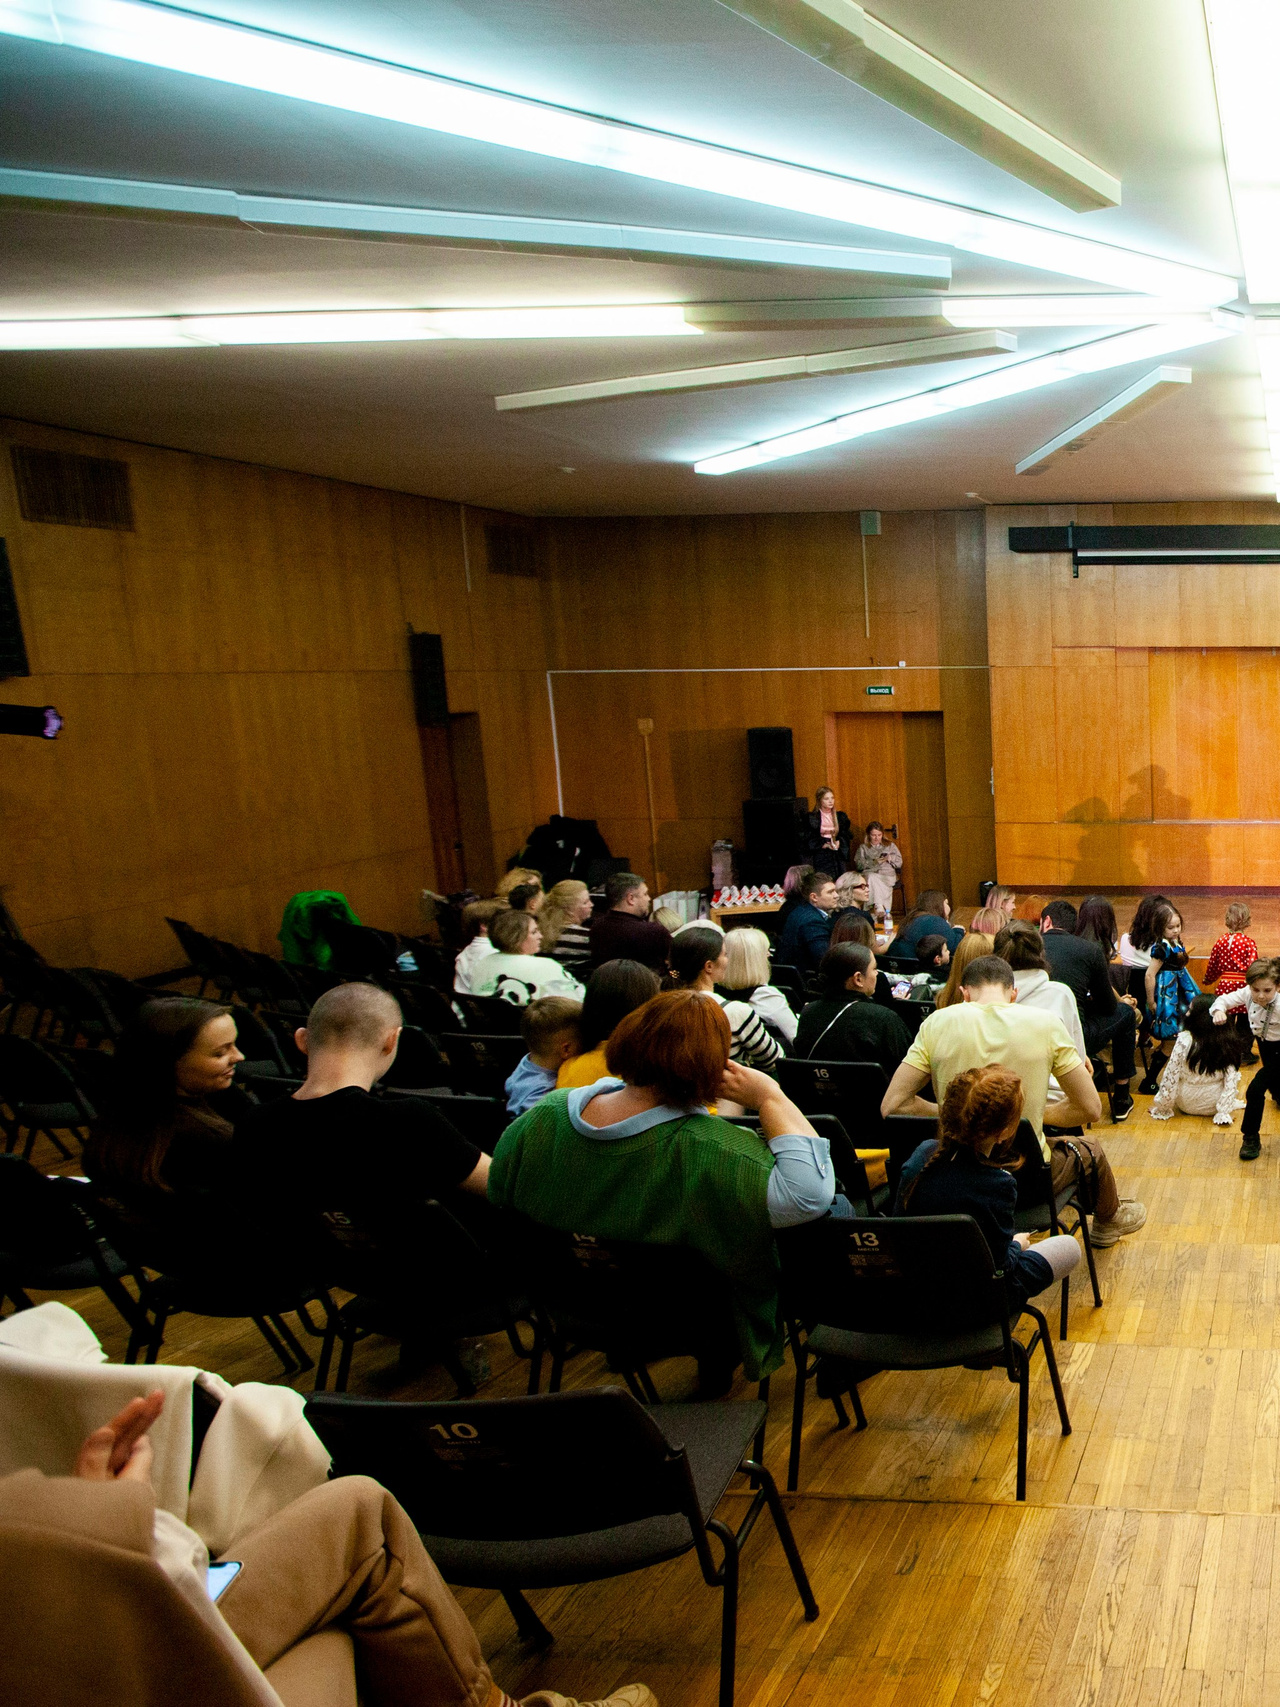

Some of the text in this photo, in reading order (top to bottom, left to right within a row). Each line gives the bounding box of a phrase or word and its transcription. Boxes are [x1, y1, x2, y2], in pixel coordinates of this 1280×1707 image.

[812, 1068, 830, 1079] 16
[322, 1211, 351, 1225] 15
[849, 1232, 880, 1247] 13
[429, 1423, 479, 1440] 10
